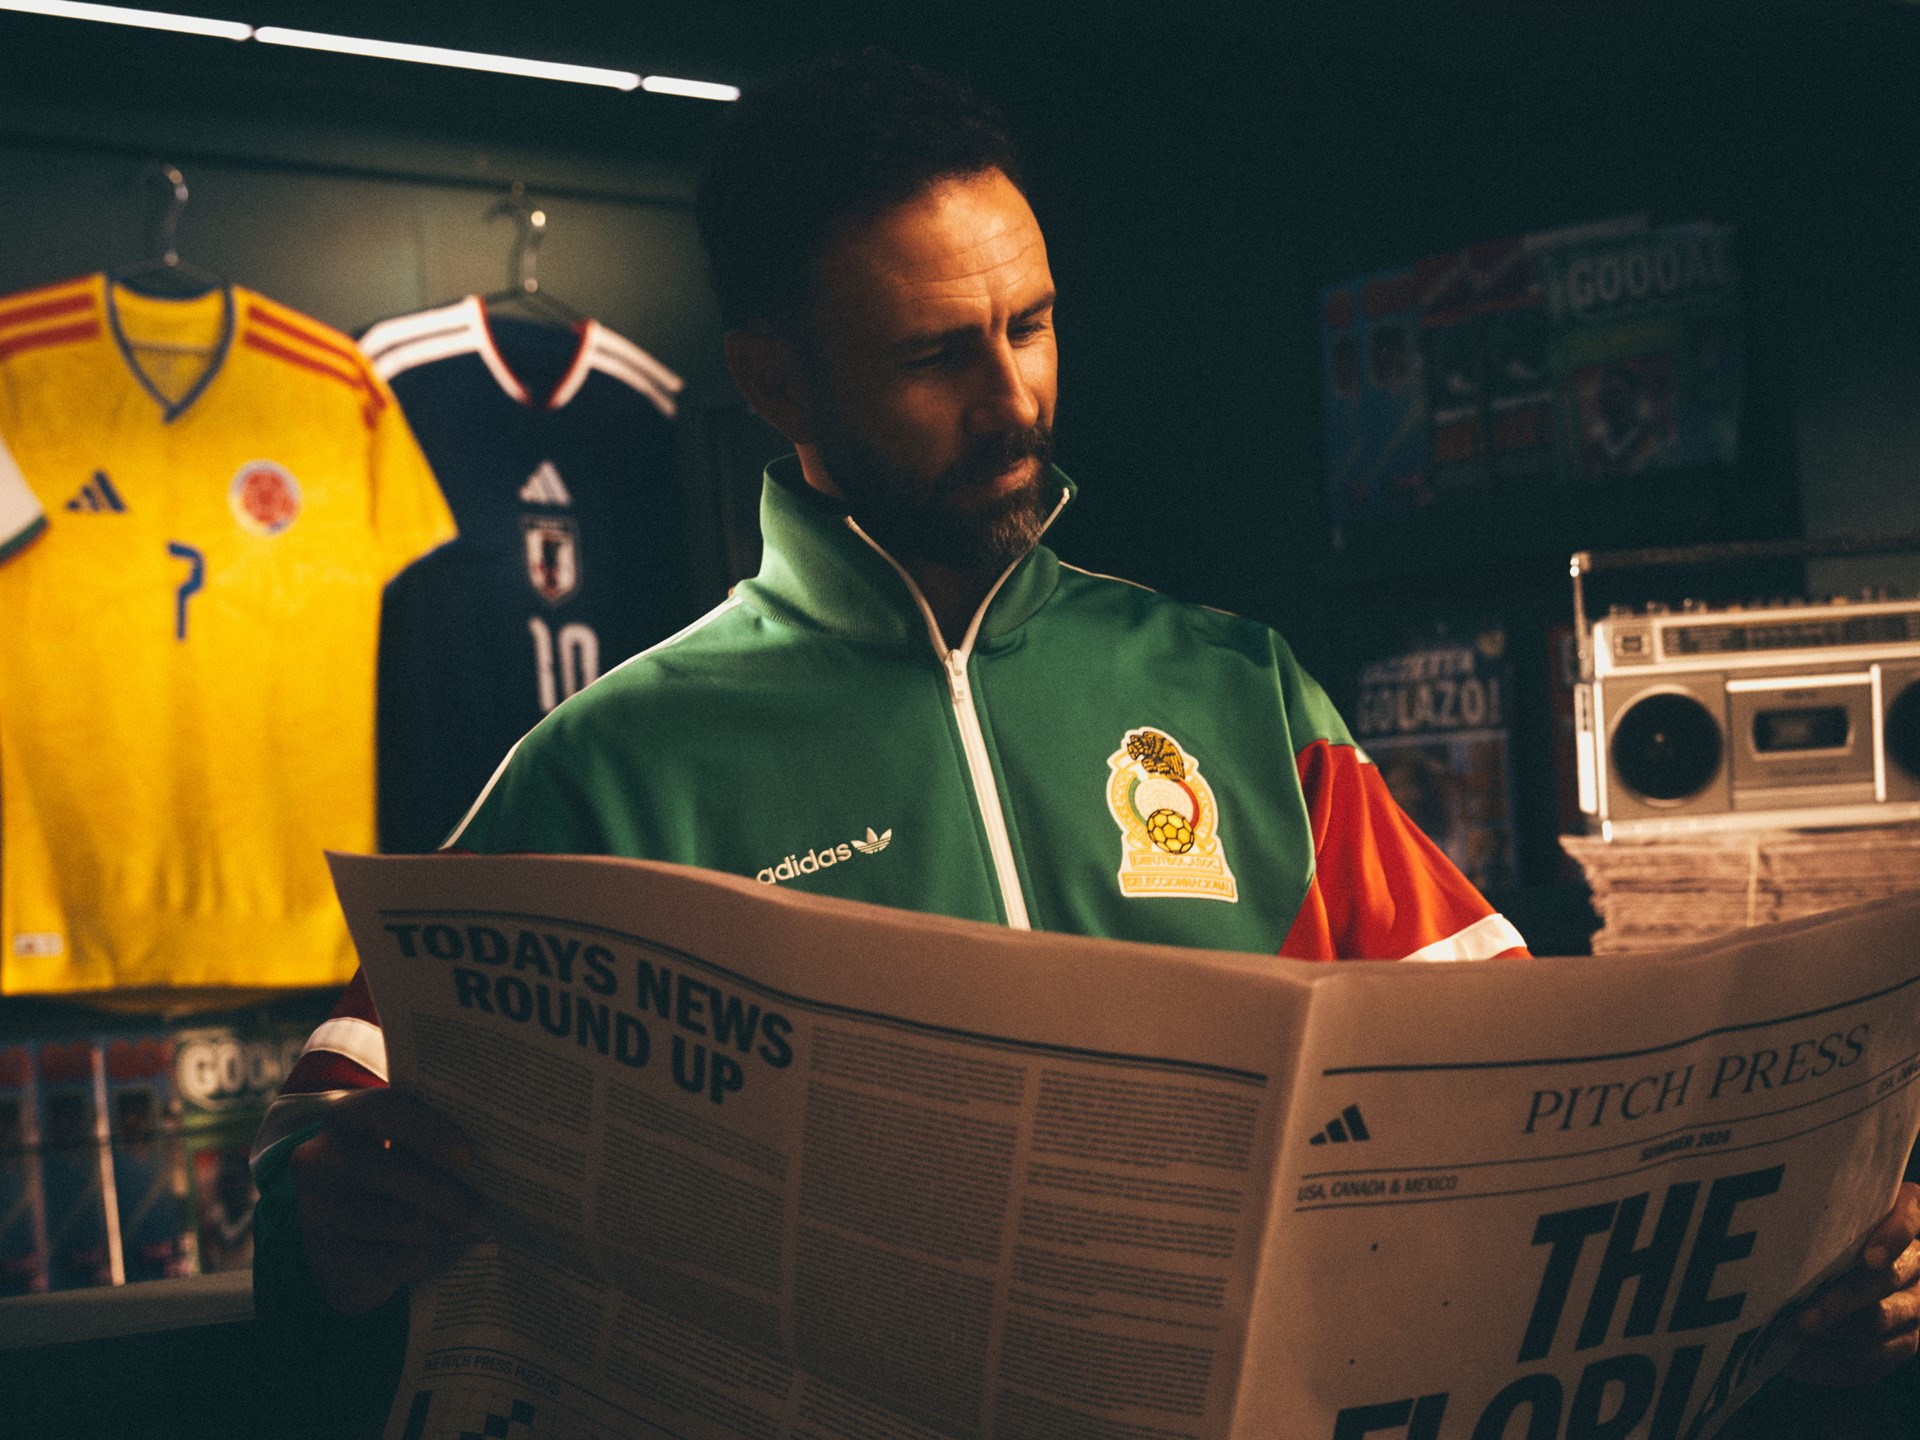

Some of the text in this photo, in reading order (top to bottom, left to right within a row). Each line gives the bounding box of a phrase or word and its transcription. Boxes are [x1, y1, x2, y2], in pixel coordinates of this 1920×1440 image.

[167, 541, 204, 642] 7
[756, 843, 852, 885] adidas
[383, 922, 794, 1070] TODAYS NEWS
[453, 967, 744, 1104] ROUND UP
[1524, 1024, 1869, 1134] PITCH PRESS
[1331, 1180, 1386, 1197] CANADA
[1390, 1177, 1400, 1194] &
[1404, 1175, 1458, 1193] MEXICO
[1639, 1129, 1731, 1161] SUMMER 2026
[1517, 1164, 1786, 1364] THE
[474, 1355, 513, 1375] PRESS
